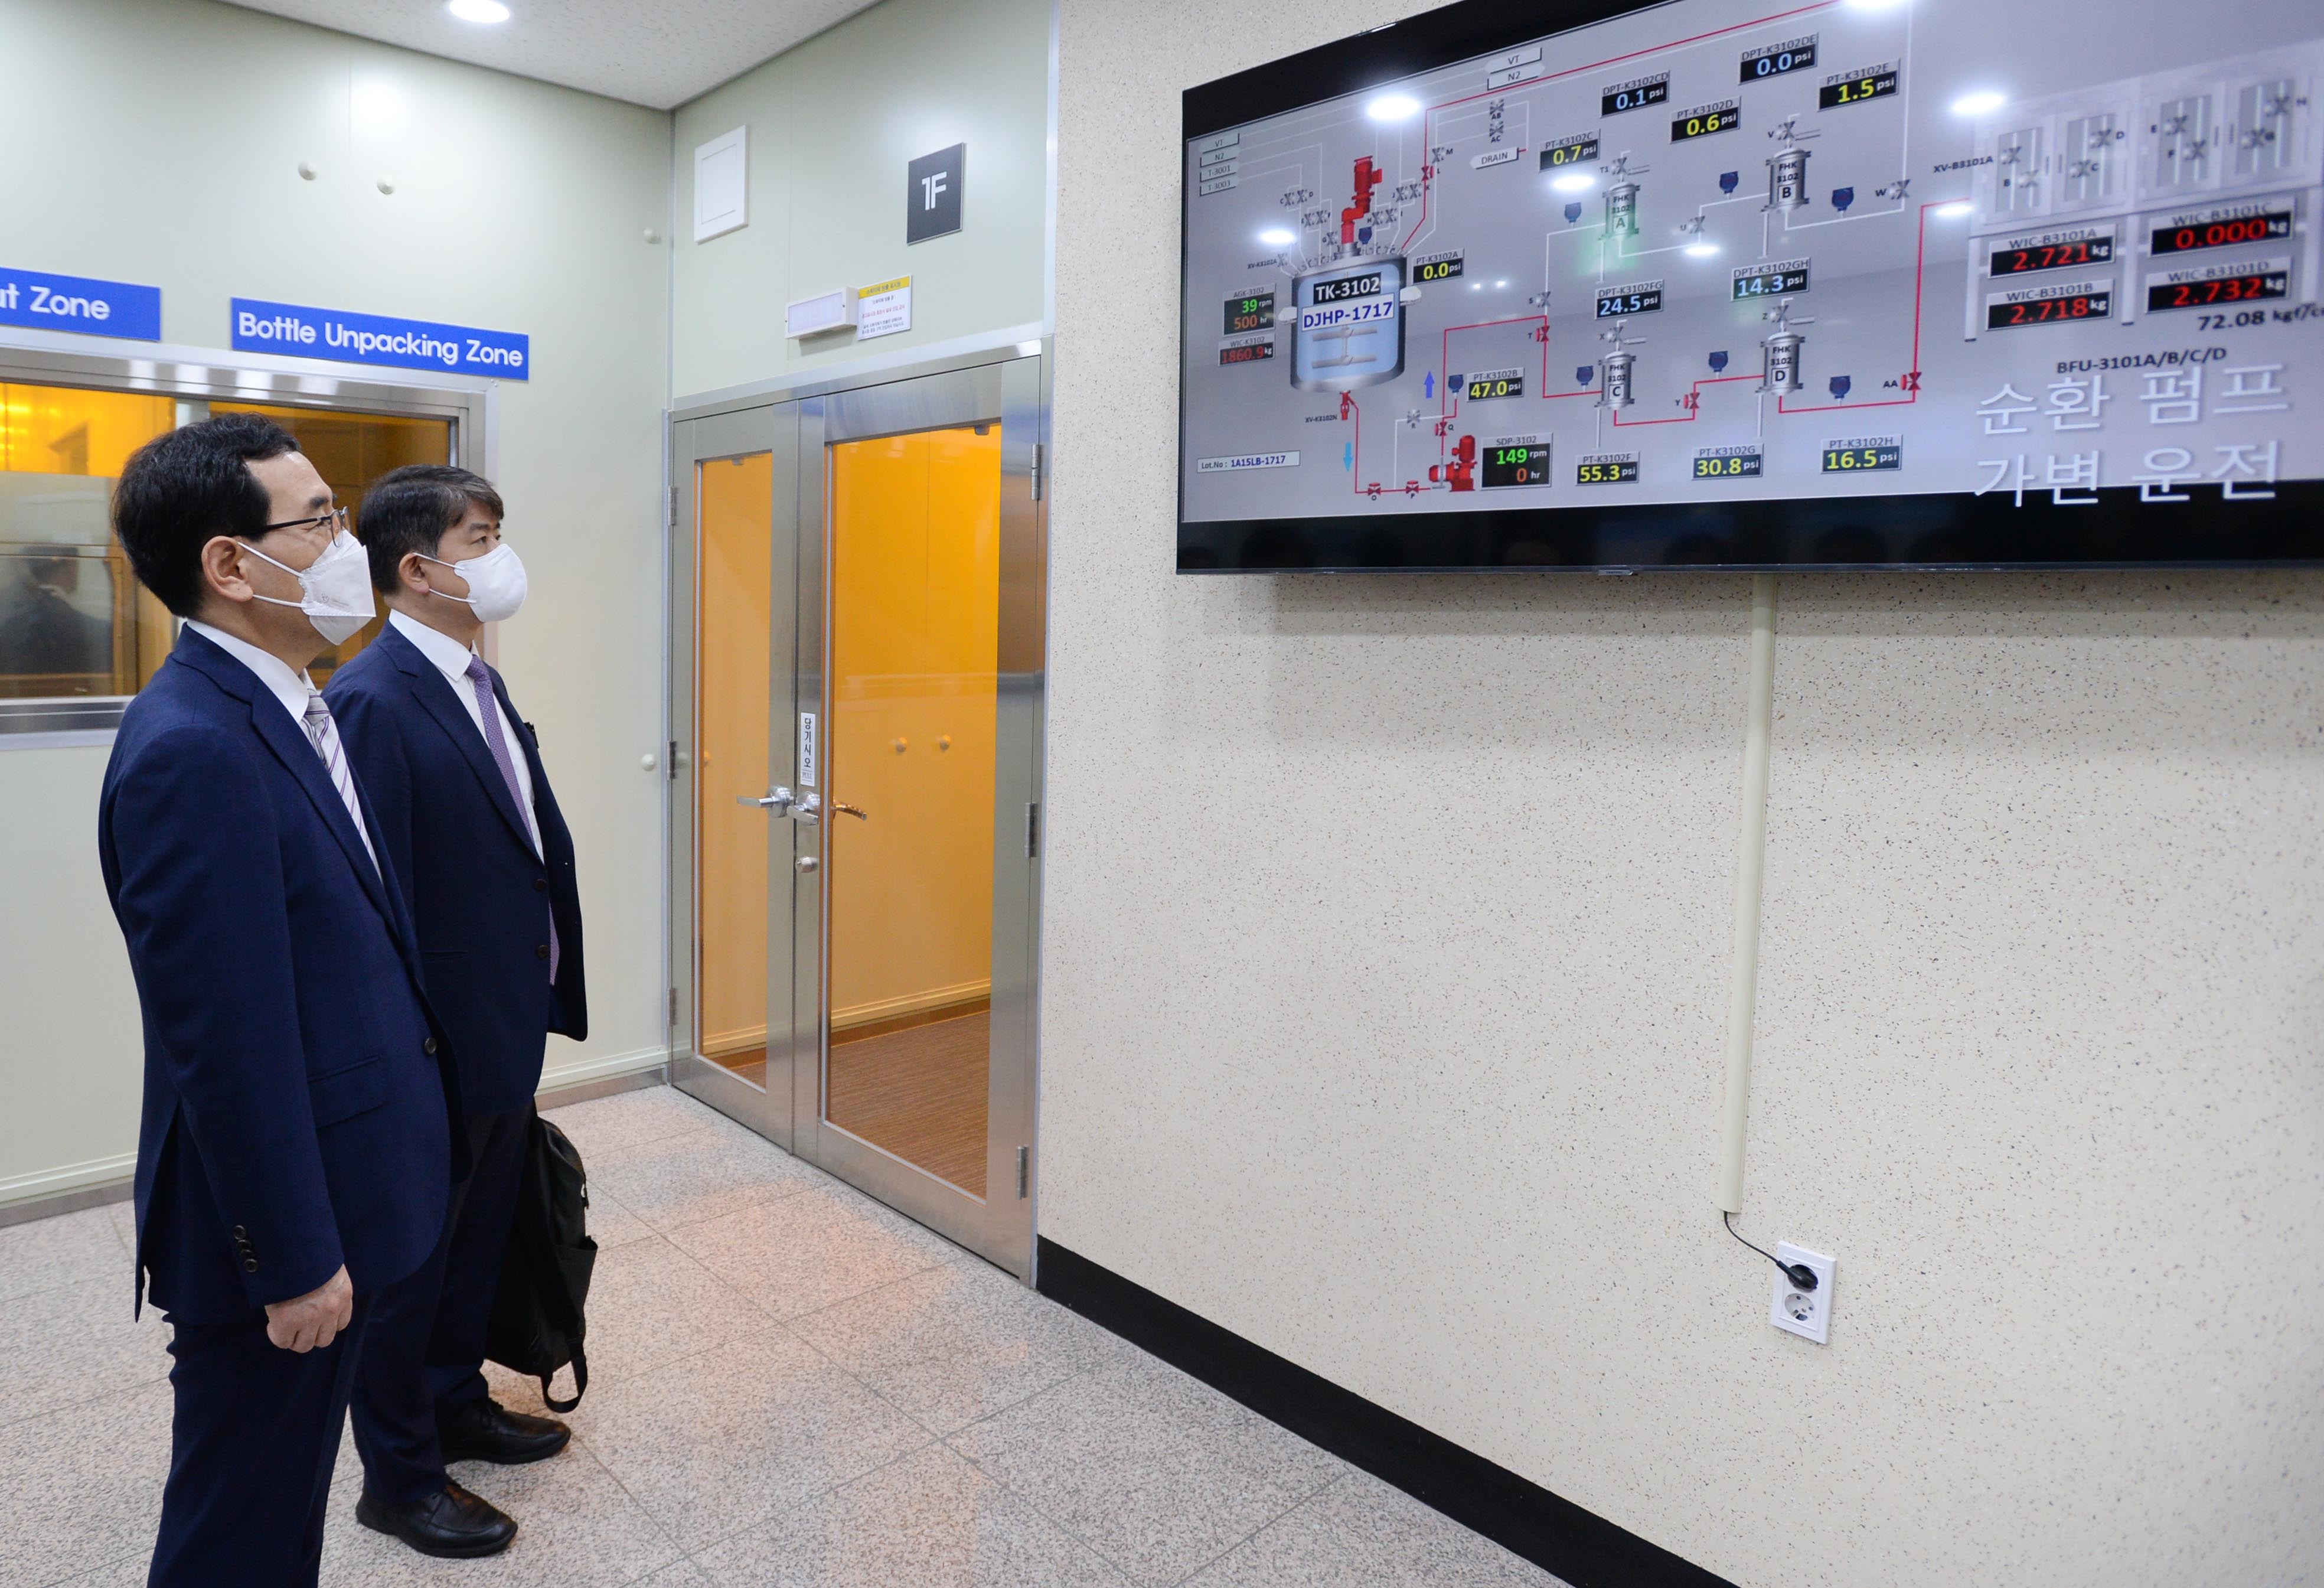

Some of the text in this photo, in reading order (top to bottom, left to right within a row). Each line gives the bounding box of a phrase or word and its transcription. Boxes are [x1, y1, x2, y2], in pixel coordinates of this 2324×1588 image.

[1742, 34, 1816, 61] DPT-K3102DE
[1508, 55, 1520, 65] VT
[1757, 51, 1811, 76] 0.0 psi
[1508, 71, 1520, 81] N2
[1827, 63, 1889, 86] PT-K3102E
[1603, 72, 1669, 95] DPT-K3102CD
[1838, 77, 1894, 103] 1.5 psi
[1616, 87, 1663, 110] 0.1 psi
[1677, 99, 1733, 119] PT-K3102D
[1686, 113, 1737, 136] 0.6 psi
[1215, 139, 1224, 147] VT
[1491, 135, 1501, 144] AC
[1546, 132, 1593, 149] PT-K3102C
[1481, 152, 1507, 164] DRAIN
[1553, 145, 1597, 165] 0.7 psi
[1779, 161, 1797, 171] FHK
[1934, 156, 1993, 173] XV-B3101A
[922, 171, 947, 211] 1F
[1613, 194, 1630, 203] FHK
[1782, 187, 1791, 198] B
[1875, 188, 1886, 197] W
[1616, 218, 1626, 229] A
[2009, 229, 2097, 249] WIC-B3101A
[2175, 219, 2267, 249] 0.000
[1416, 251, 1458, 265] PT-K3102A
[2013, 243, 2108, 270] 2.721 kg
[1423, 263, 1461, 280] 0.0 psi
[1734, 260, 1809, 278] DPT-K3102GH
[1316, 276, 1380, 301] TK-3102
[1598, 281, 1663, 298] DPT-K3102FG
[1738, 275, 1803, 296] 14.3 psi
[2006, 283, 2093, 302] WIC-B3101B
[2173, 277, 2262, 306] 2.732
[30, 285, 110, 320] Zone
[1242, 299, 1272, 313] 39 rpm
[1600, 295, 1658, 316] 24.5 psi
[2010, 298, 2107, 324] 2.718 kg
[1234, 316, 1258, 330] 500
[1304, 301, 1393, 328] DJHP-1717
[2198, 311, 2265, 331] 72.08
[239, 312, 523, 367] Bottle Unpacking Zone
[1773, 345, 1791, 354] FHK
[1771, 357, 1792, 366] 3102
[2057, 347, 2227, 373] BFU-3101A/B/C/D
[1474, 370, 1517, 381] PT-K3102B
[1775, 370, 1786, 381] D
[1471, 381, 1521, 397] 47.0 psi
[1613, 386, 1621, 396] C
[1977, 364, 2288, 434] 순환 펌프
[1496, 436, 1536, 446] SDP-3102
[1829, 437, 1893, 448] PT-K3102H
[1496, 448, 1547, 465] 149 rpm
[1582, 454, 1631, 464] PT-K3102F
[1699, 445, 1755, 456] PT-K3102G
[1231, 455, 1285, 468] 1A15LB-1717
[1696, 458, 1758, 476] 30.8 psi
[1827, 450, 1897, 469] 16.5 psi
[1516, 468, 1540, 482] 0 hr
[1580, 465, 1636, 482] 55.3 psi
[1974, 441, 2277, 507] 가변 운전
[804, 718, 812, 768] 당기시오
